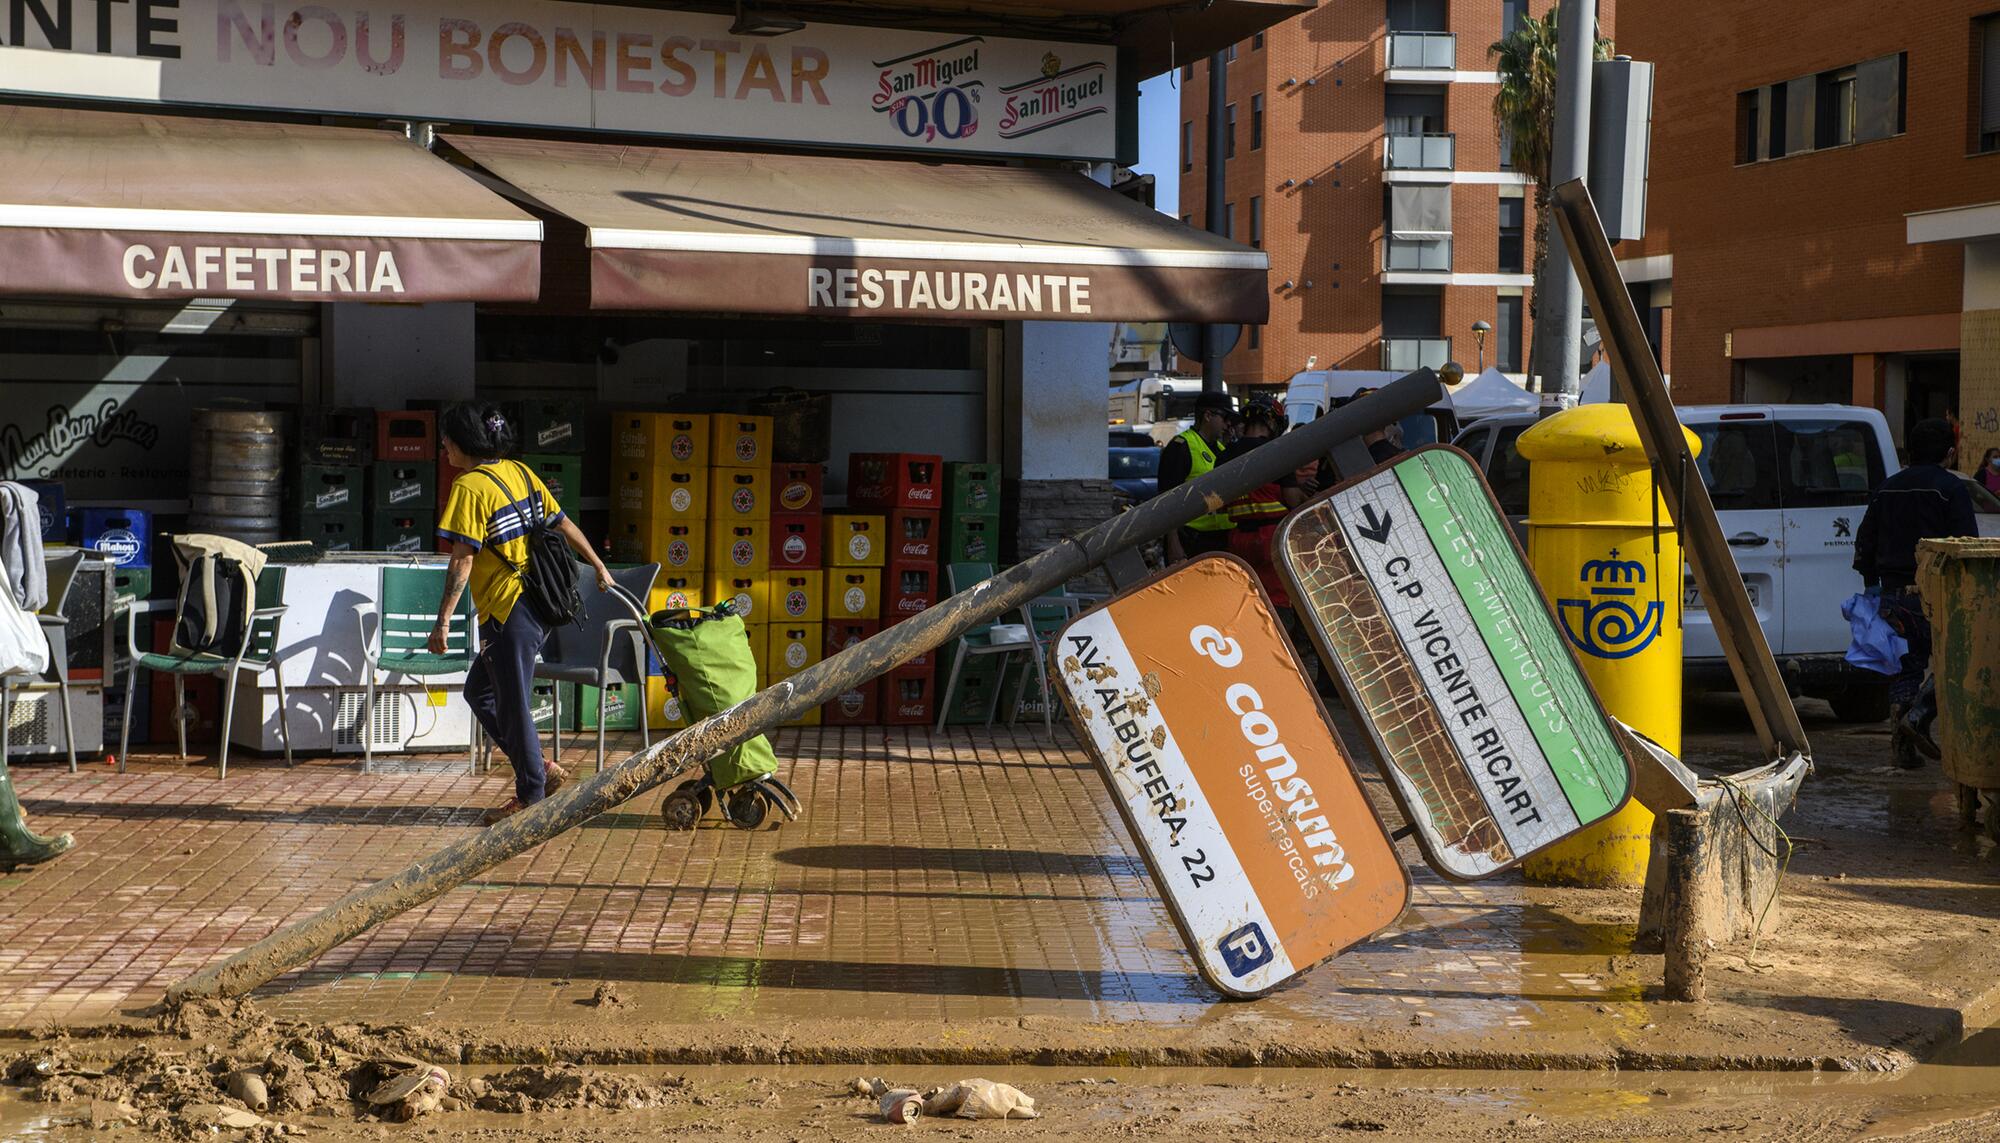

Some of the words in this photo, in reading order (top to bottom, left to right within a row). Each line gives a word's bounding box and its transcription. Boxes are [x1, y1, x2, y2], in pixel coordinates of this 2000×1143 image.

[0, 0, 181, 59] NTE
[217, 0, 406, 75] NOU
[440, 17, 832, 106] BONESTAR
[122, 244, 405, 293] CAFETERIA
[808, 267, 1092, 314] RESTAURANTE
[120, 467, 191, 479] Restauran
[100, 541, 135, 552] Mahou
[1443, 514, 1484, 568] LES
[1414, 608, 1488, 727] VICENTE
[1472, 727, 1542, 827] RICART
[1094, 688, 1188, 847] ALBUFERA,
[1181, 849, 1215, 888] 22
[1225, 683, 1355, 891] consum
[1239, 763, 1318, 900] supermercats
[1228, 930, 1262, 961] P
